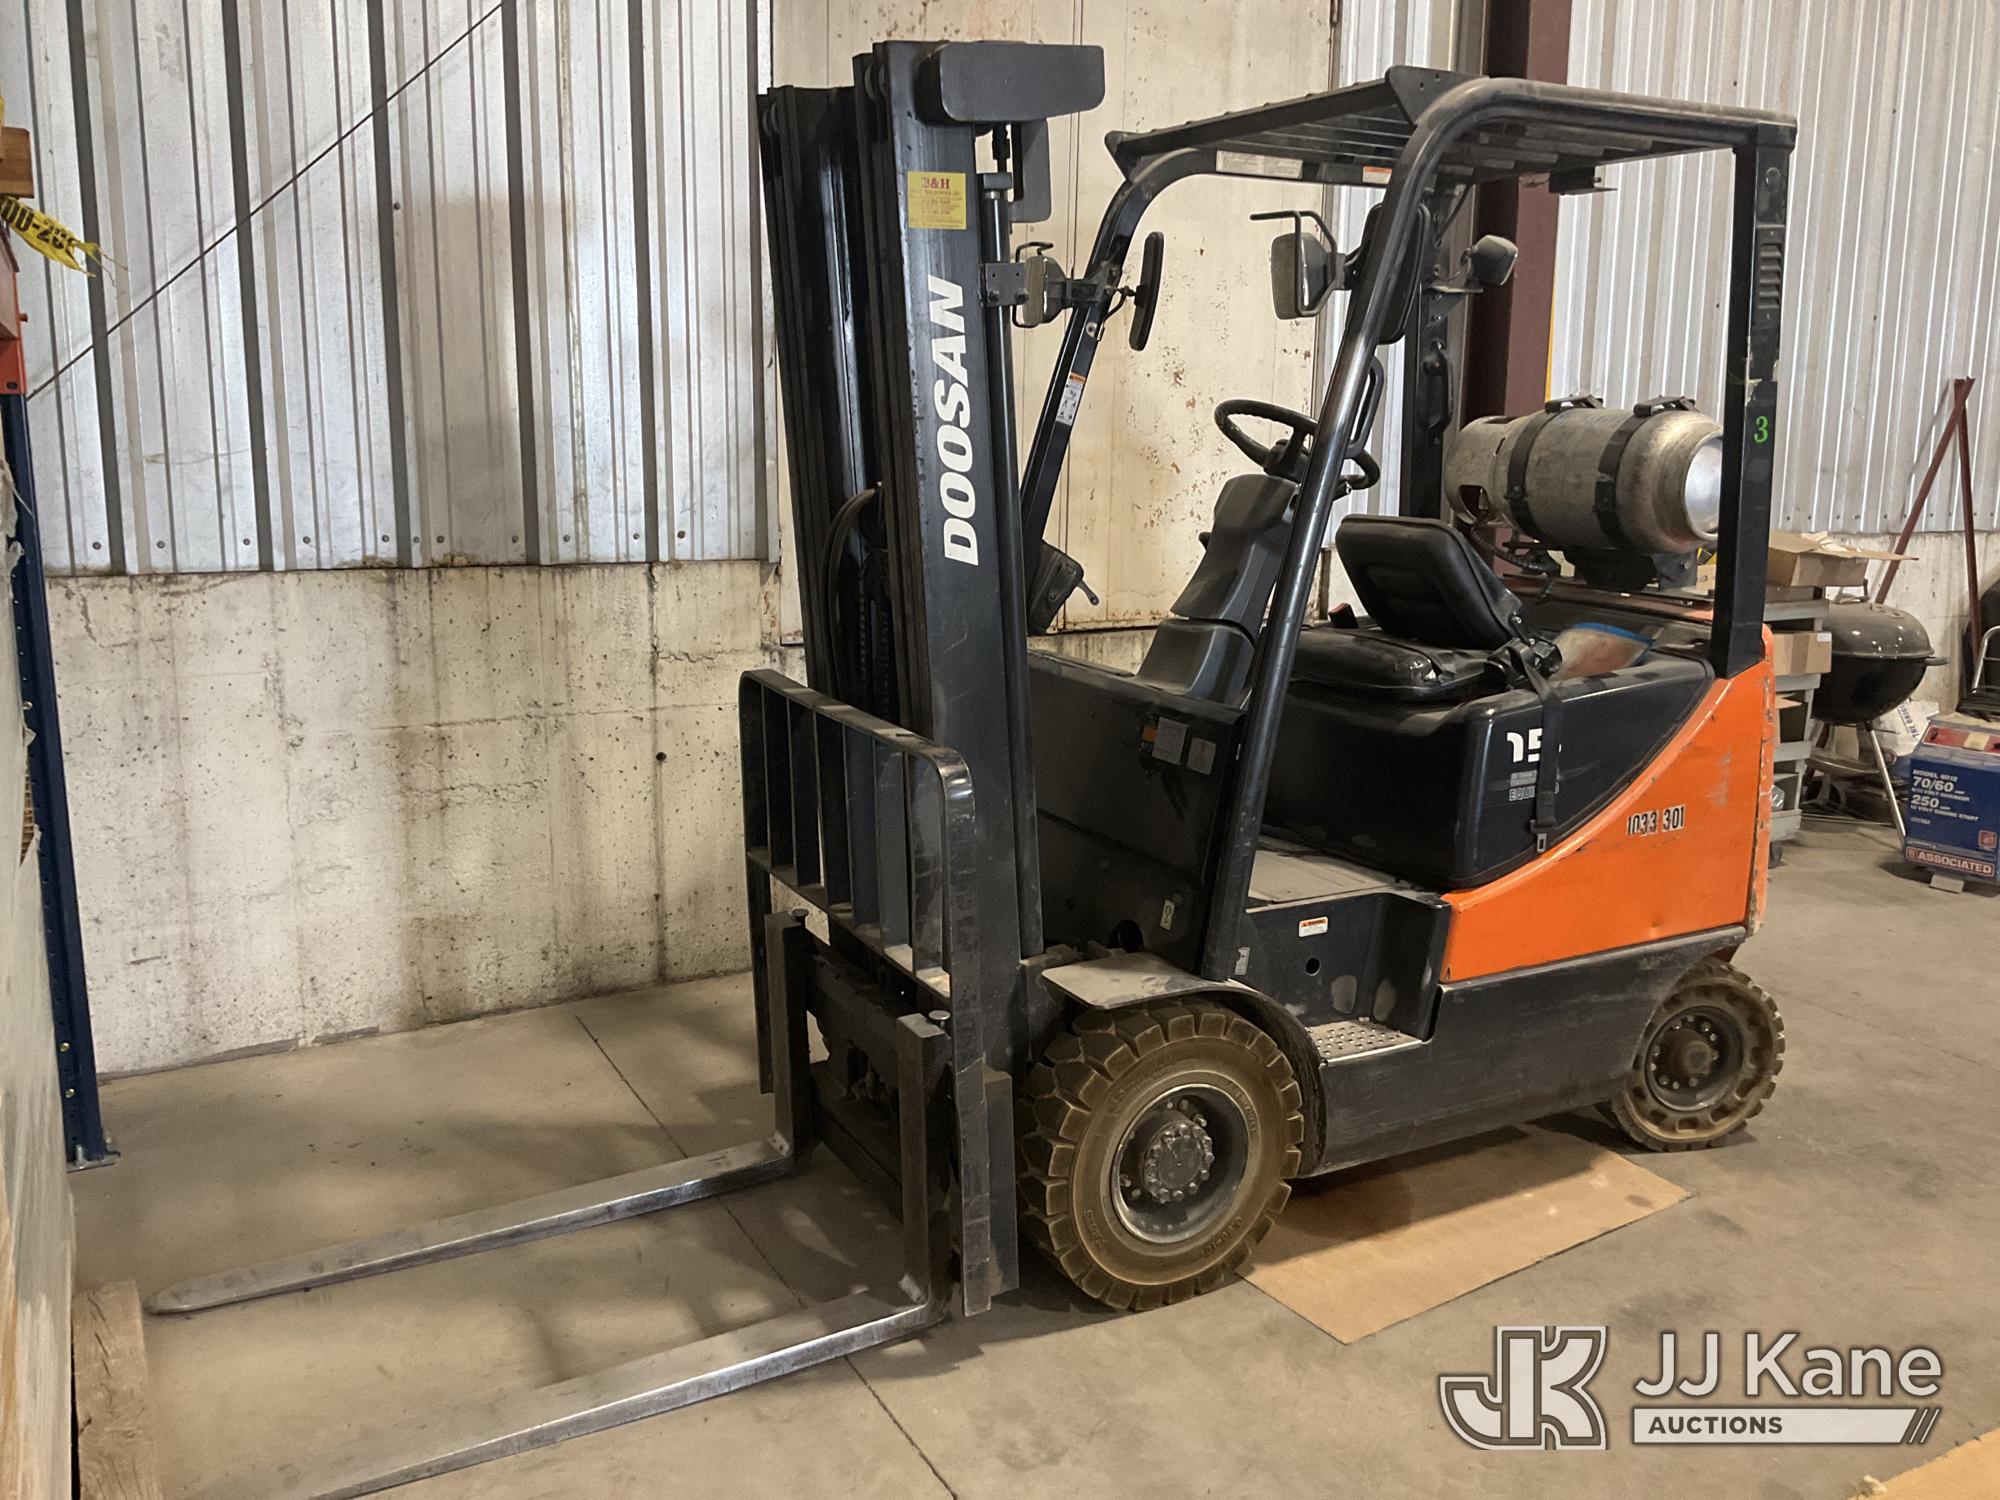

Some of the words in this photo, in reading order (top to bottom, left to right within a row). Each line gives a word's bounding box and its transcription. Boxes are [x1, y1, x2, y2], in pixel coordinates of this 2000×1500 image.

[927, 274, 979, 567] DOOSAN
[1753, 415, 1769, 443] 3
[1912, 776, 1954, 792] 70/60
[1910, 794, 1940, 808] 250
[1626, 810, 1658, 836] 1033
[1663, 805, 1685, 831] 301
[1918, 851, 1992, 874] ASSOCIATED
